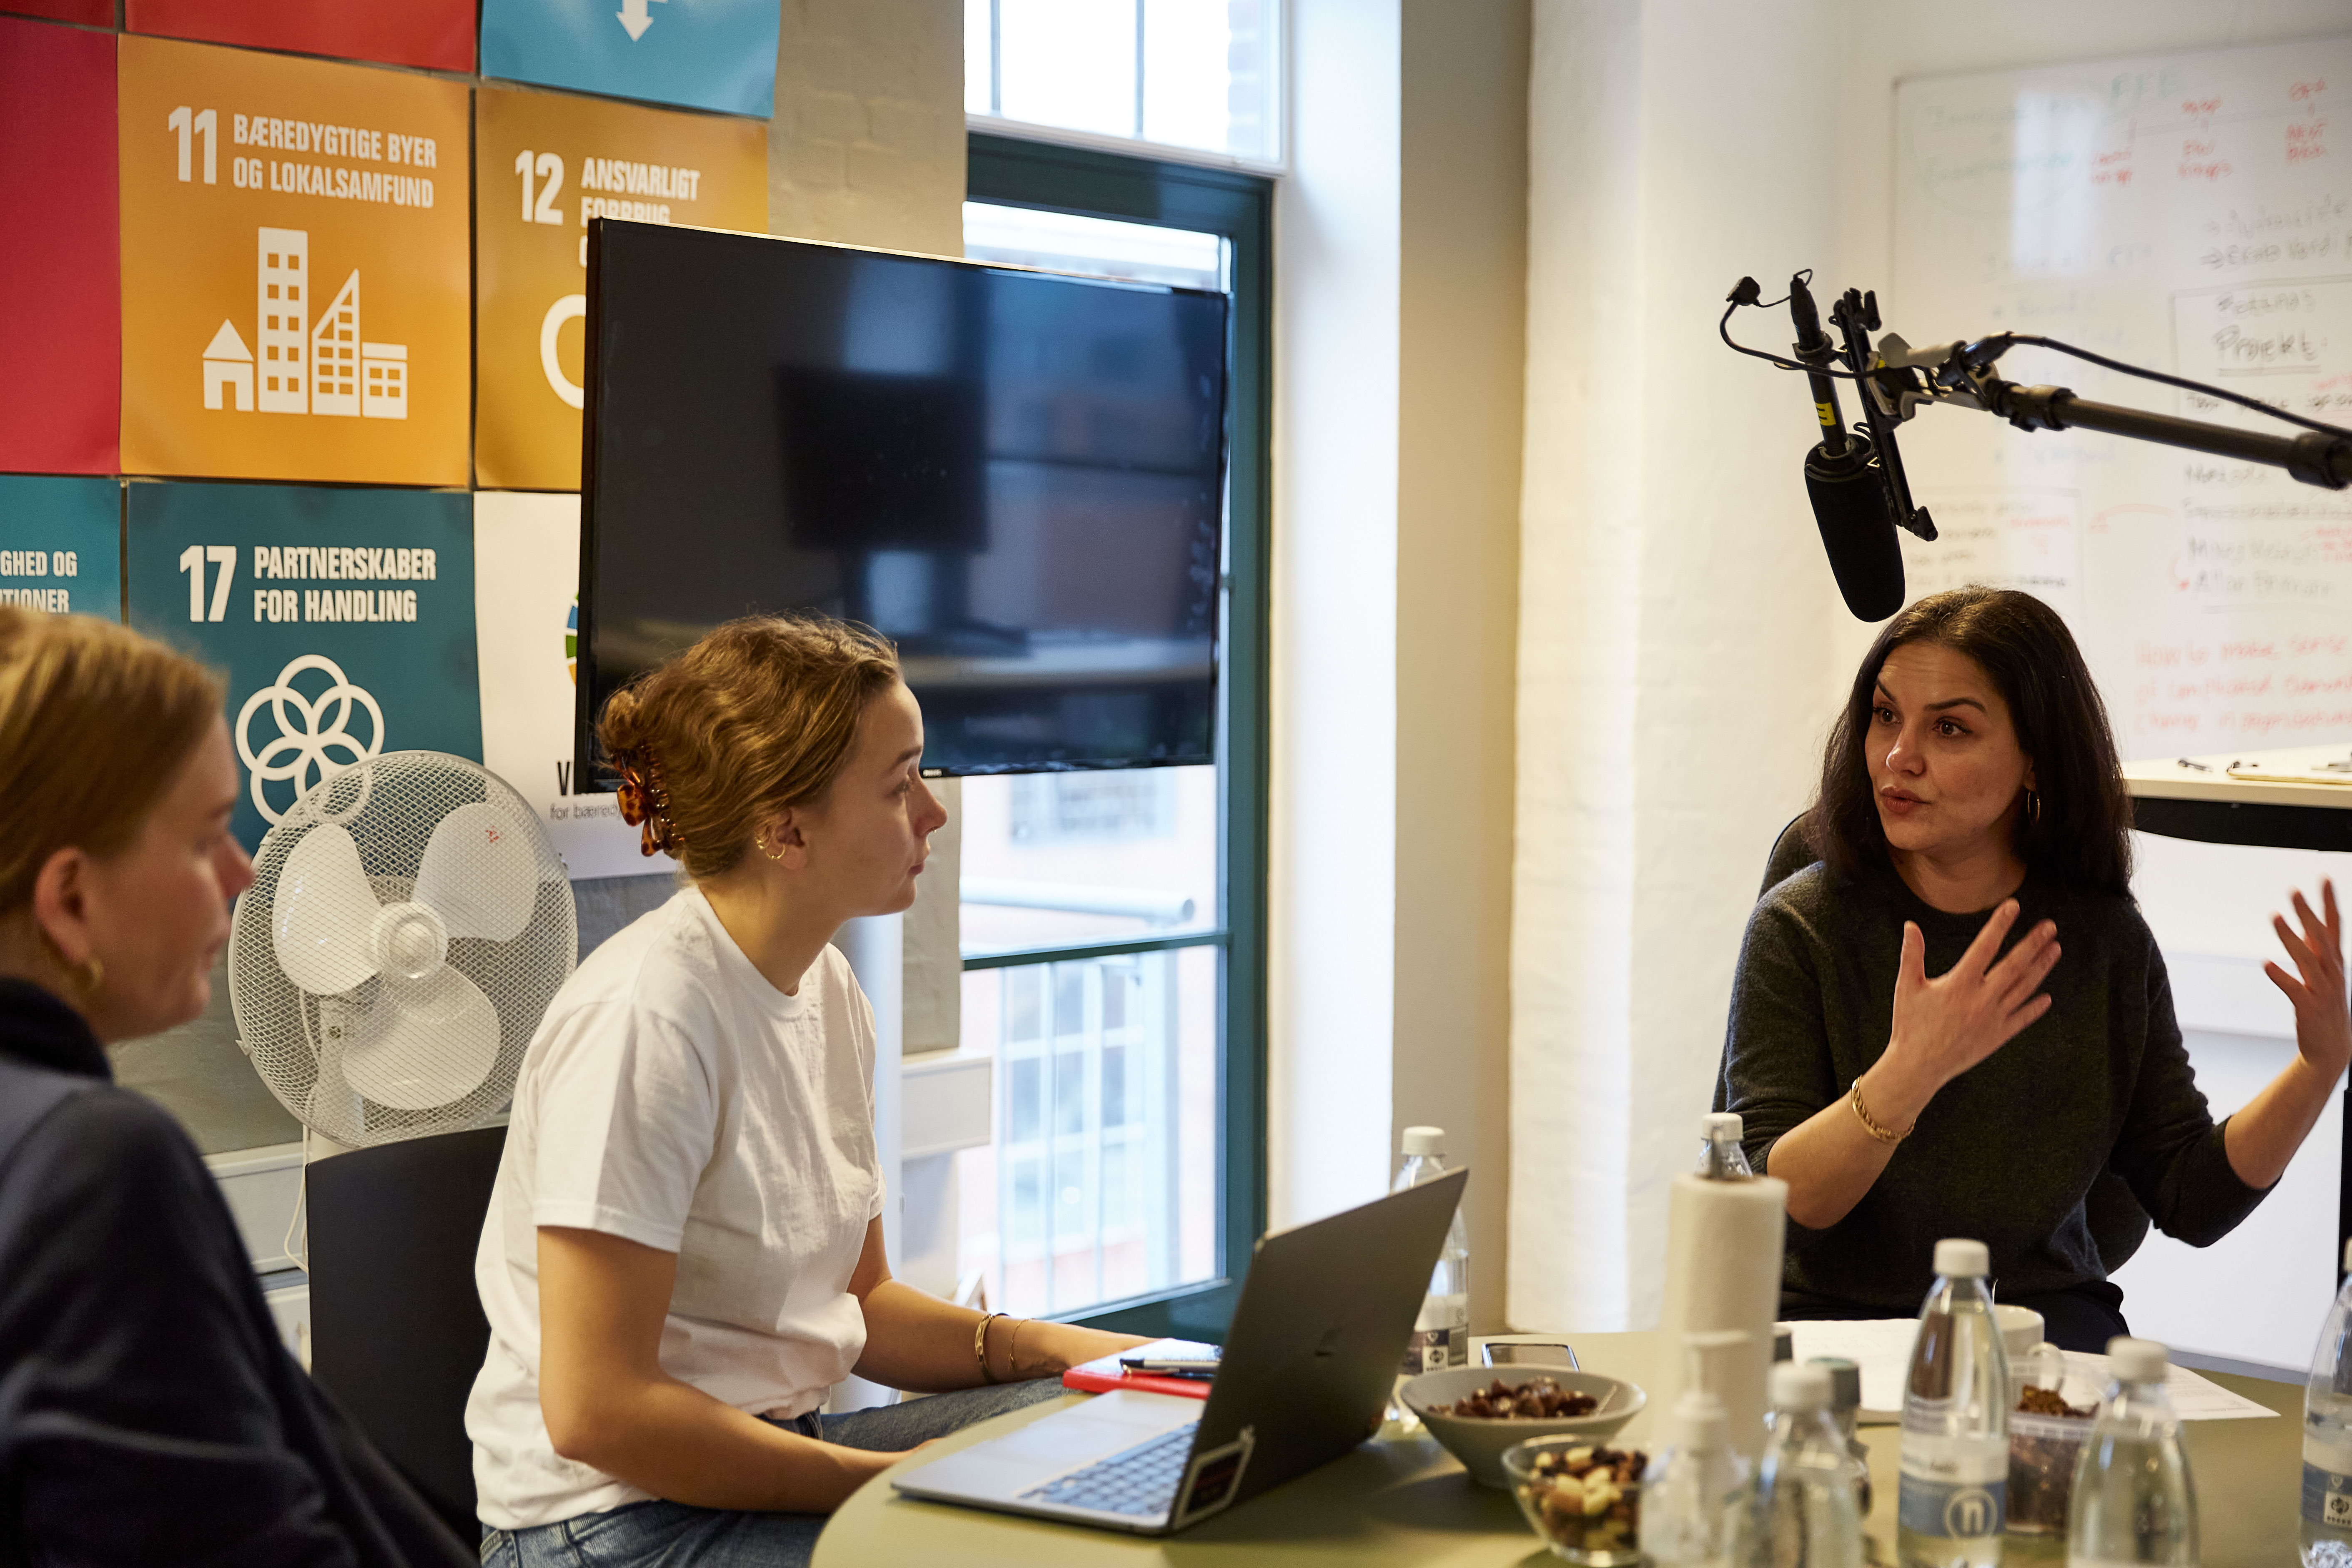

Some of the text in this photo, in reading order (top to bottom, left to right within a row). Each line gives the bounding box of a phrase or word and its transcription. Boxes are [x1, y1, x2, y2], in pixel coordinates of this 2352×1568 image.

[168, 106, 217, 184] 11
[233, 113, 436, 168] BÆREDYGTIGE BYER
[233, 156, 434, 208] OG LOKALSAMFUND
[515, 150, 564, 226] 12
[581, 157, 700, 201] ANSVARLIGT
[53, 551, 78, 577] OG
[180, 545, 236, 622] 17
[254, 546, 436, 580] PARTNERSKABER
[0, 588, 70, 613] TIONER
[254, 589, 417, 622] FOR HANDLING
[550, 803, 570, 820] for
